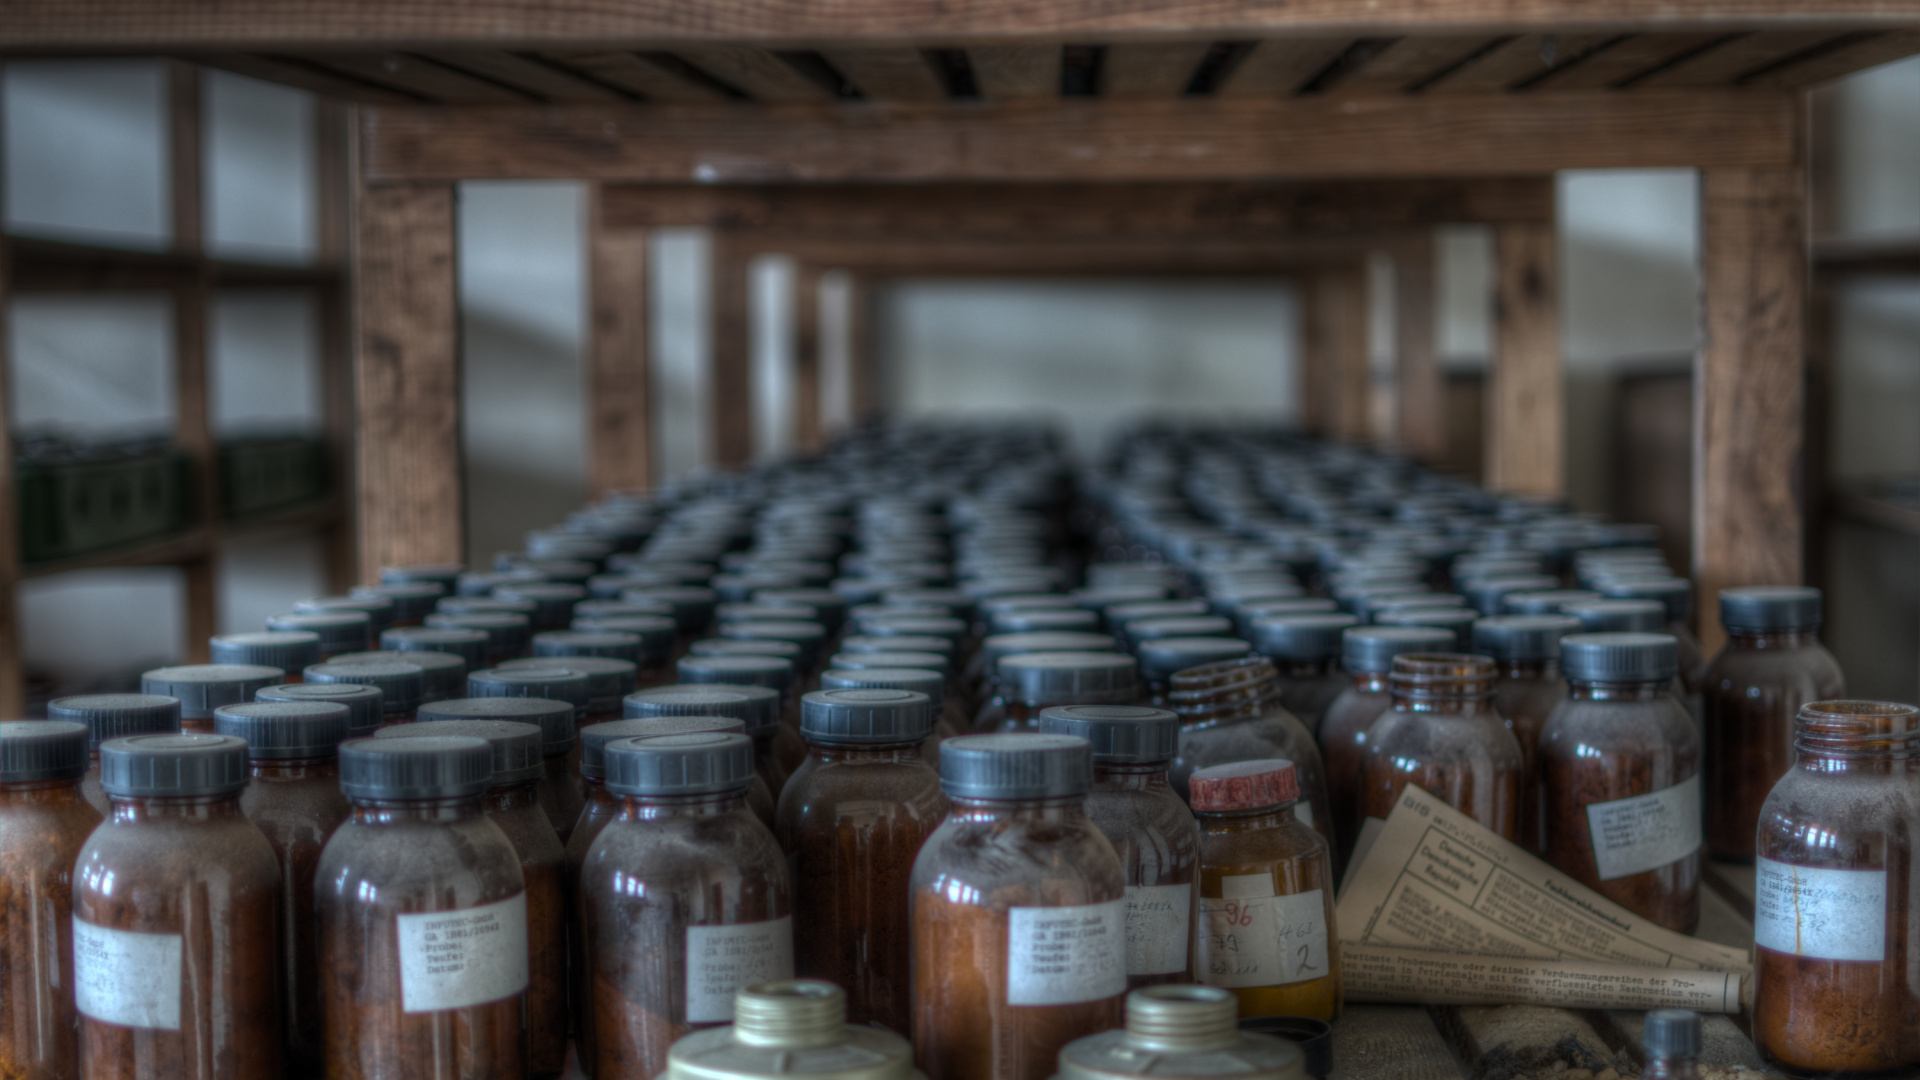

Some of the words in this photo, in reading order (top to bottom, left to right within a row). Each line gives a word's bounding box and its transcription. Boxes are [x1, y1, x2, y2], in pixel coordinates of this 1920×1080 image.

[1421, 846, 1478, 886] Demokratische
[1439, 840, 1475, 869] Deutsche
[1225, 903, 1252, 927] 96
[425, 932, 438, 942] GA
[426, 942, 463, 953] Probe:
[427, 953, 463, 963] Teufe:
[428, 963, 464, 974] Datum:
[704, 963, 741, 973] Probe:
[1296, 944, 1318, 976] 2
[706, 973, 741, 983] Teufe:
[1362, 962, 1395, 973] werden
[1418, 966, 1484, 982] Petrischalen
[1489, 974, 1506, 983] mit
[1512, 975, 1530, 985] dem
[1534, 979, 1613, 994] verfluessigten
[1620, 984, 1683, 998] Naehrmedium
[1688, 991, 1712, 999] ver-
[1397, 955, 1458, 970] Probemengen
[1463, 963, 1486, 972] oder
[1491, 964, 1536, 976] dezimale
[1542, 968, 1644, 985] Verduennungsreihen
[1649, 977, 1668, 987] der
[1672, 978, 1696, 988] Pro-
[1378, 974, 1395, 982] und
[1428, 978, 1444, 987] bei
[1484, 981, 1538, 995] inkubiert.
[1546, 986, 1562, 997] Die
